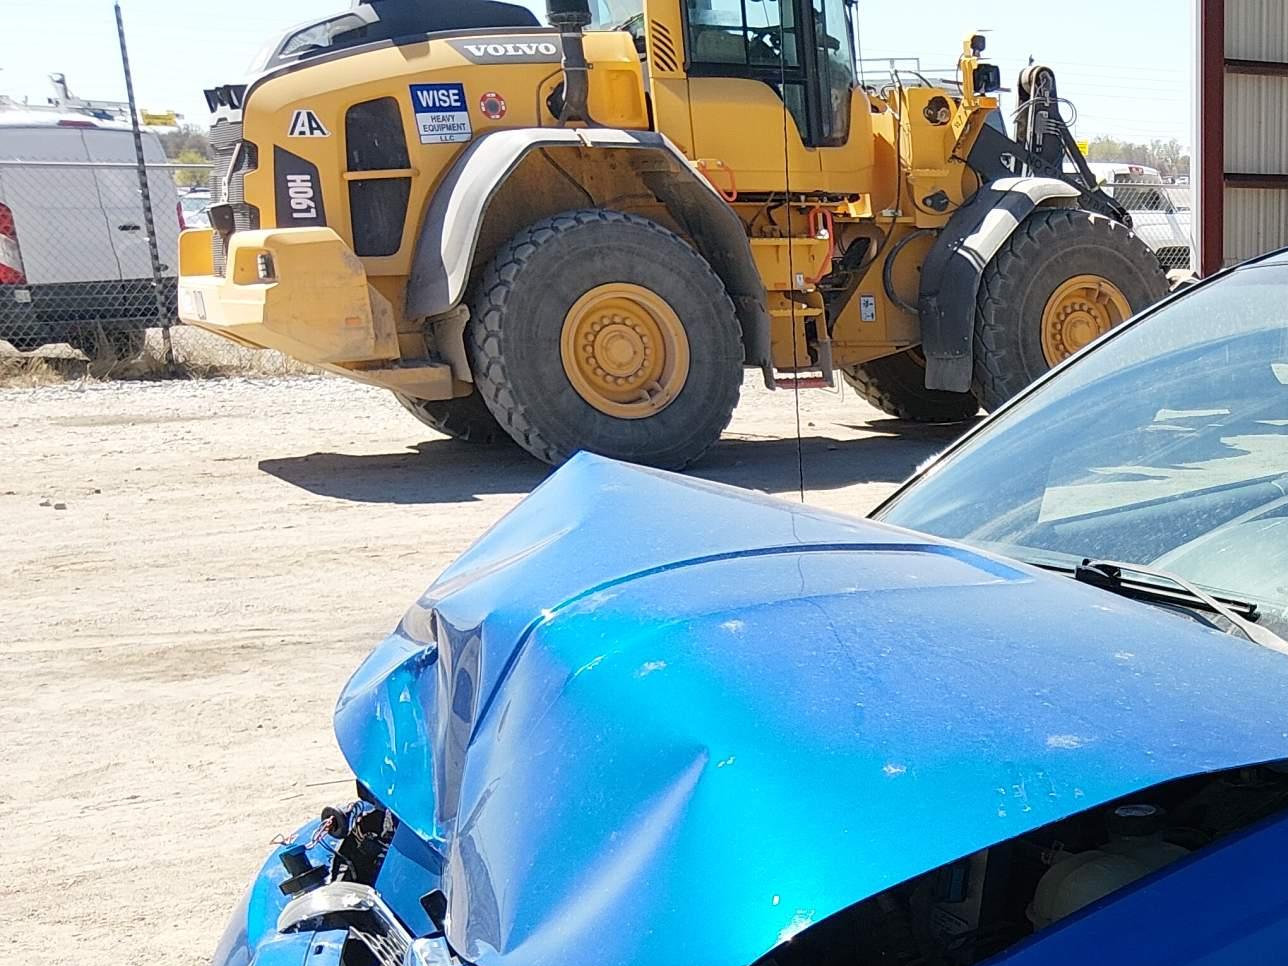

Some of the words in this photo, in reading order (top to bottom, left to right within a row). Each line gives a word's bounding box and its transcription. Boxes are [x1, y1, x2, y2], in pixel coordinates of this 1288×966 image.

[463, 42, 557, 57] VOLVO
[416, 89, 461, 108] WISE
[430, 115, 455, 123] HEAVY
[423, 123, 466, 133] EQUIPMENT
[440, 134, 455, 142] LLC
[286, 174, 317, 218] L90H
